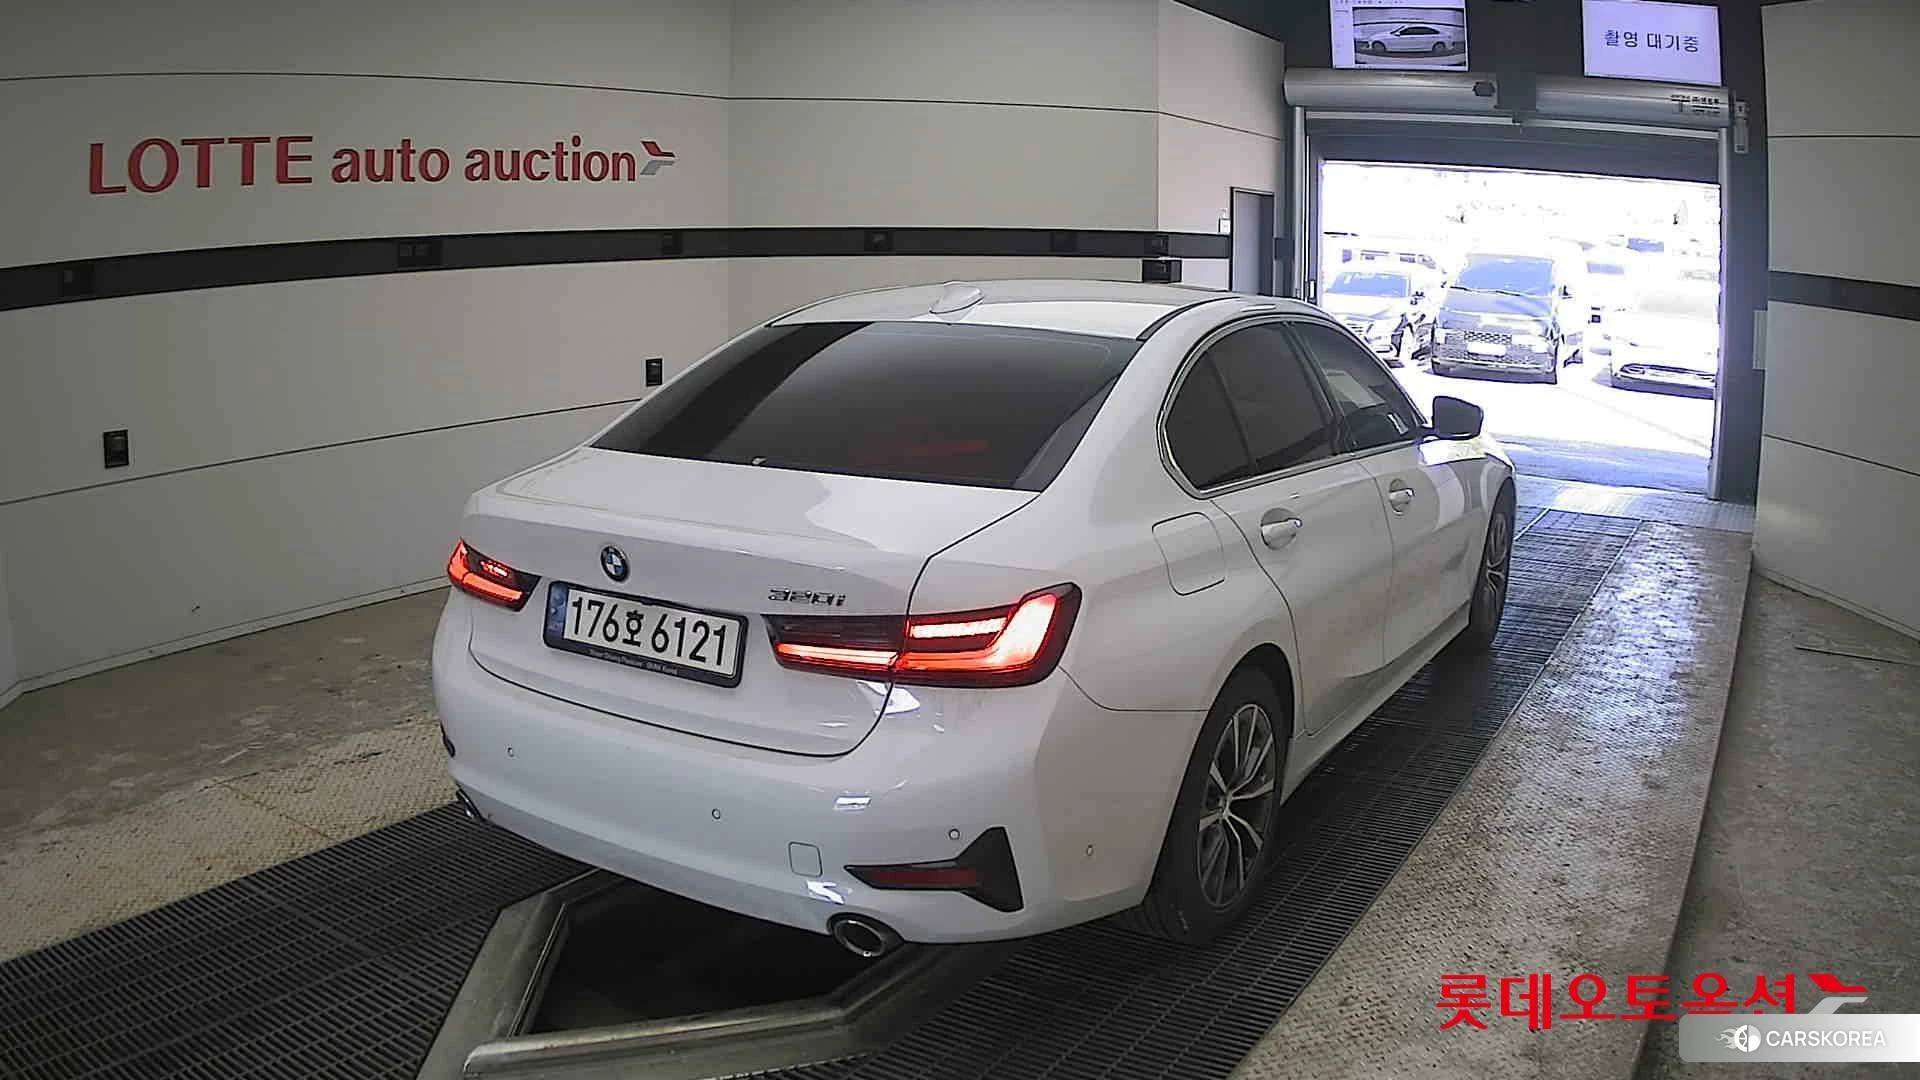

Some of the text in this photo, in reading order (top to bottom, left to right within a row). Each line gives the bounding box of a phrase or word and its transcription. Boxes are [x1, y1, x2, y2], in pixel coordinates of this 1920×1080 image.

[1604, 29, 1699, 53] 촬영 대기중
[89, 135, 638, 195] LOTTE auto auction
[571, 596, 645, 648] 176호
[651, 612, 727, 667] 6121
